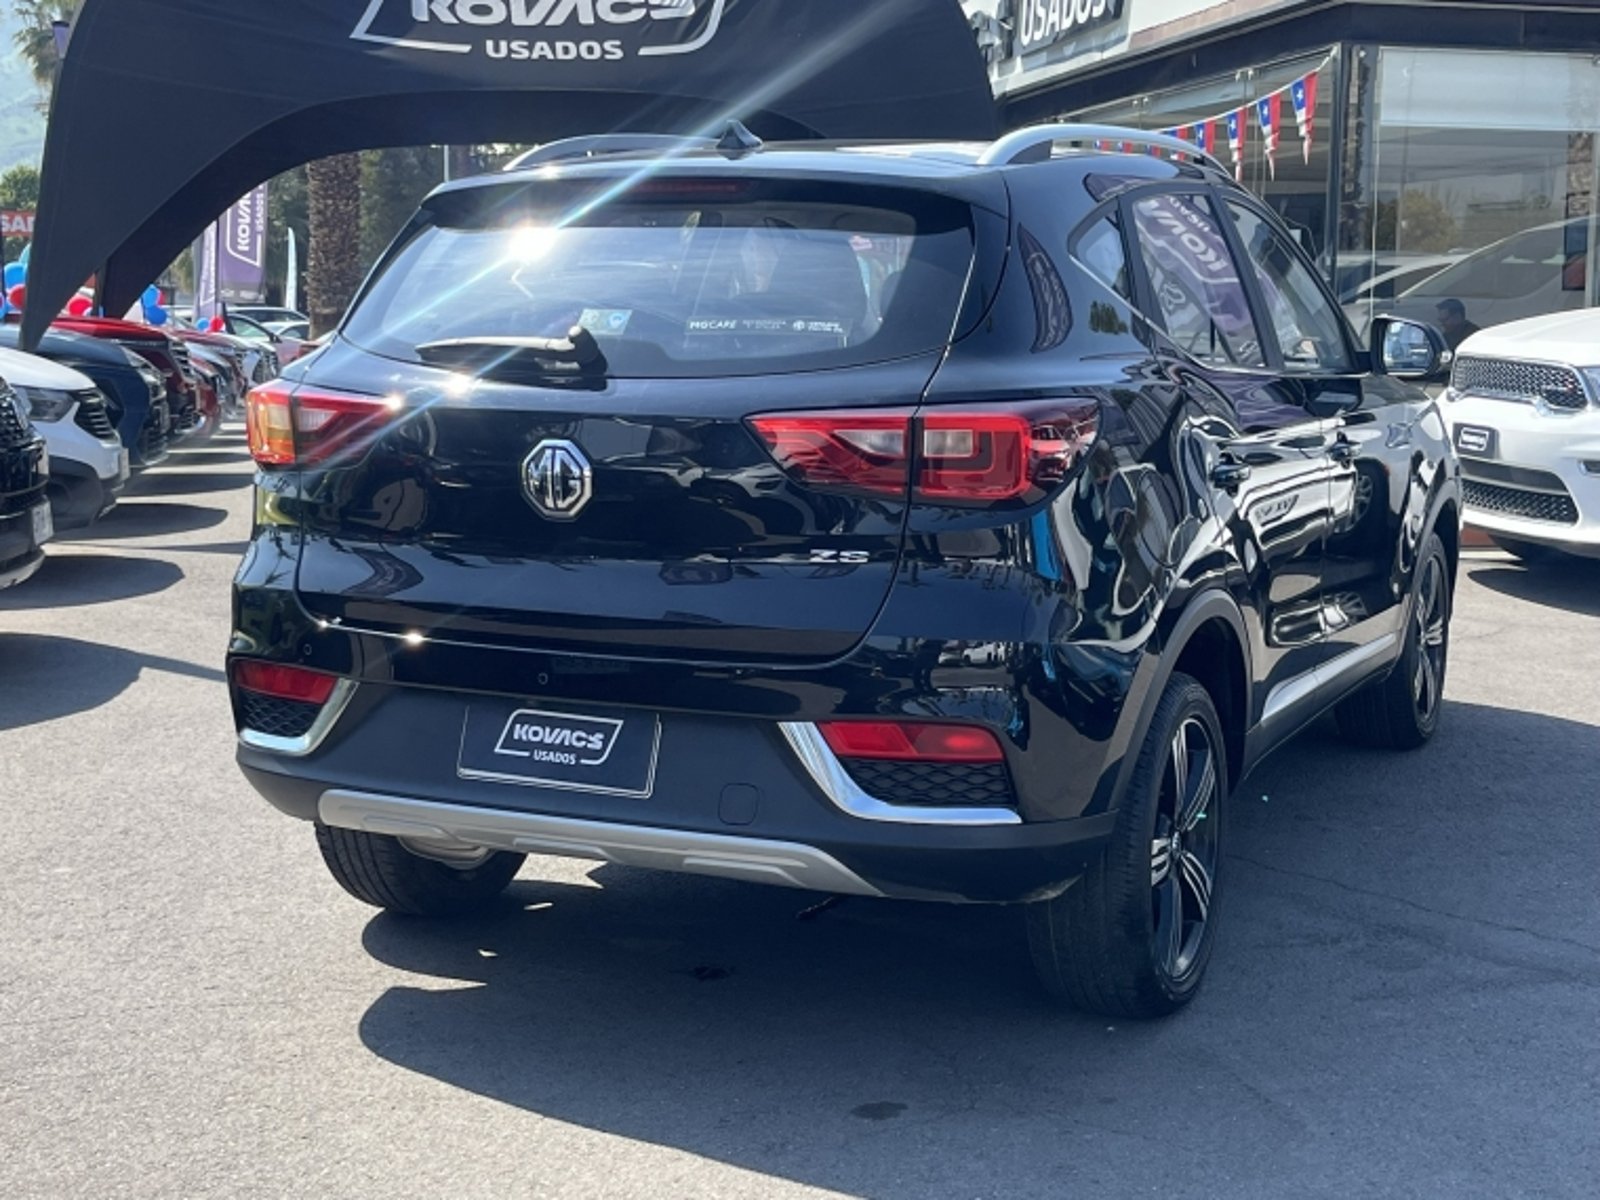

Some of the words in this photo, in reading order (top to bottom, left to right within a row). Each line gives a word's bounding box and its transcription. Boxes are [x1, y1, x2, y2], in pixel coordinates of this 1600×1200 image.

[411, 0, 696, 26] KOVACS
[485, 39, 624, 60] USADOS
[525, 445, 583, 511] MG
[809, 548, 871, 564] ZS
[513, 723, 605, 750] KOVACS
[533, 750, 577, 765] USADOS
